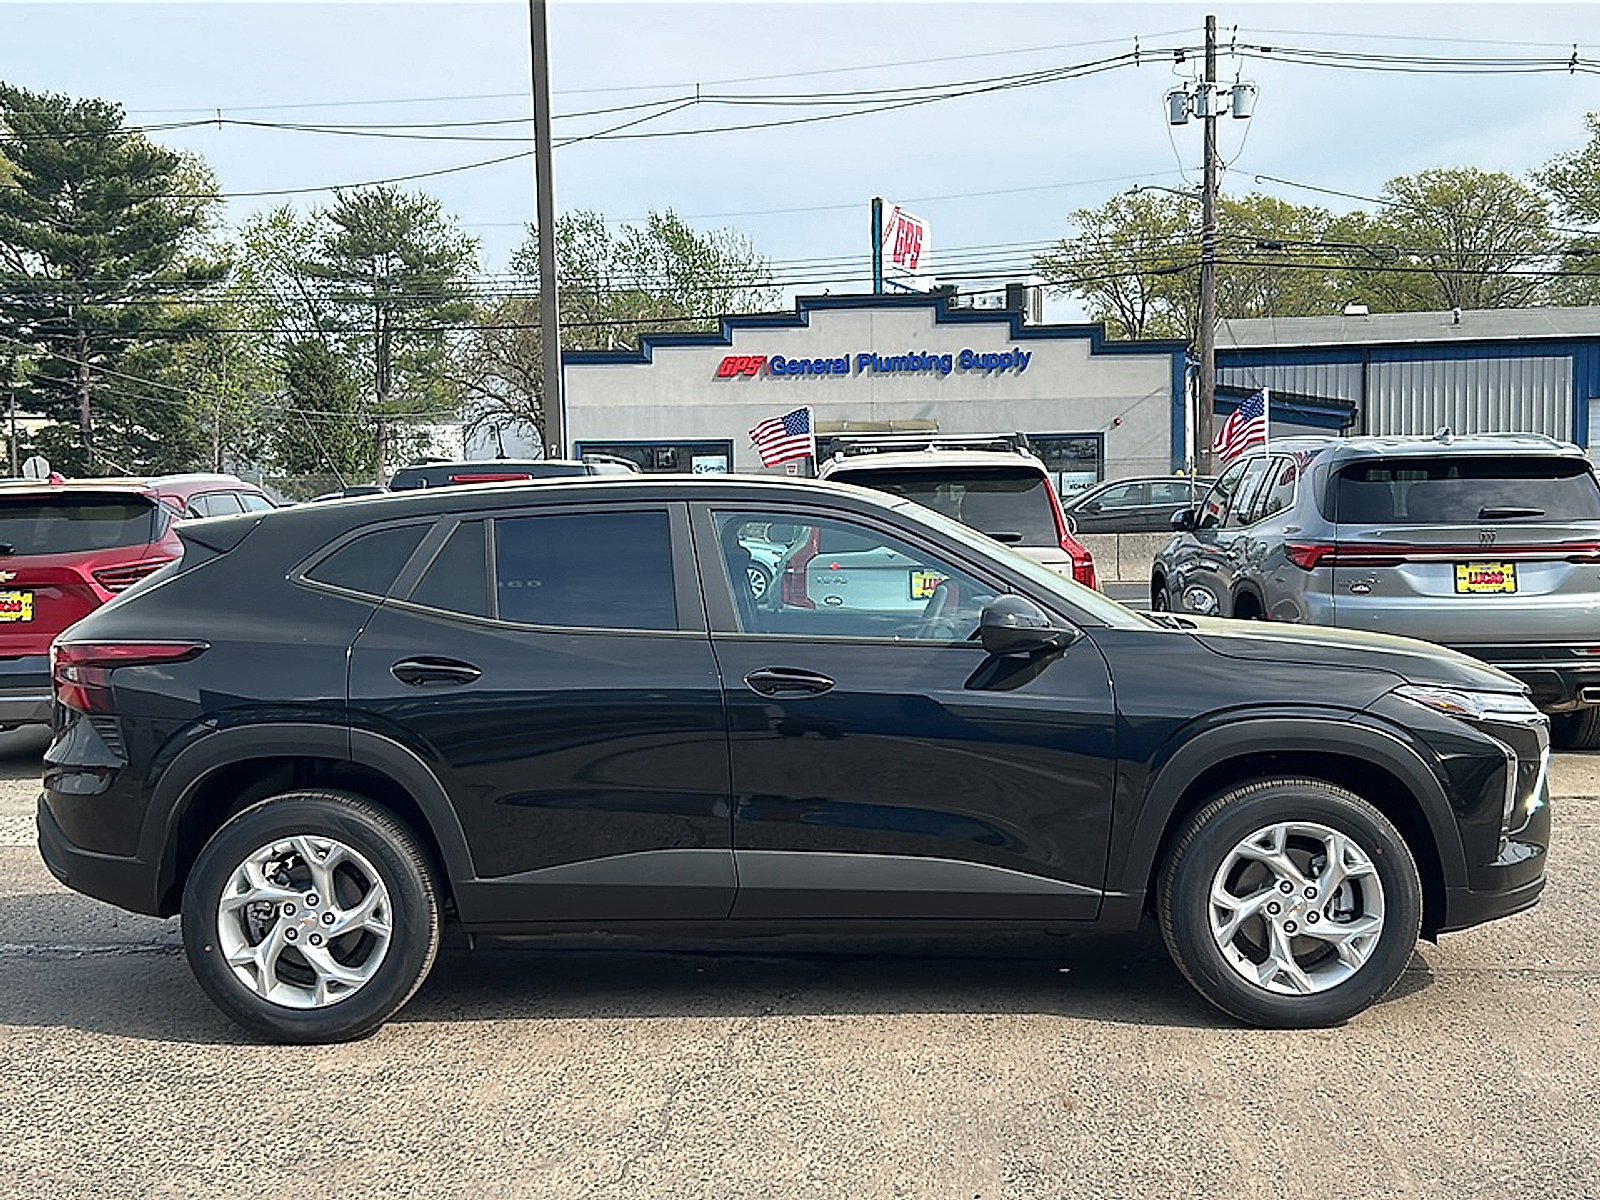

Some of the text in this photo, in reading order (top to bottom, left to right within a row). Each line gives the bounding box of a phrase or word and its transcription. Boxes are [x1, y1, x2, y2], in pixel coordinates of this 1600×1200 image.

[893, 217, 923, 269] GPS
[717, 346, 1033, 378] GPS General Plumbing Supply
[1468, 571, 1505, 585] LUCAS
